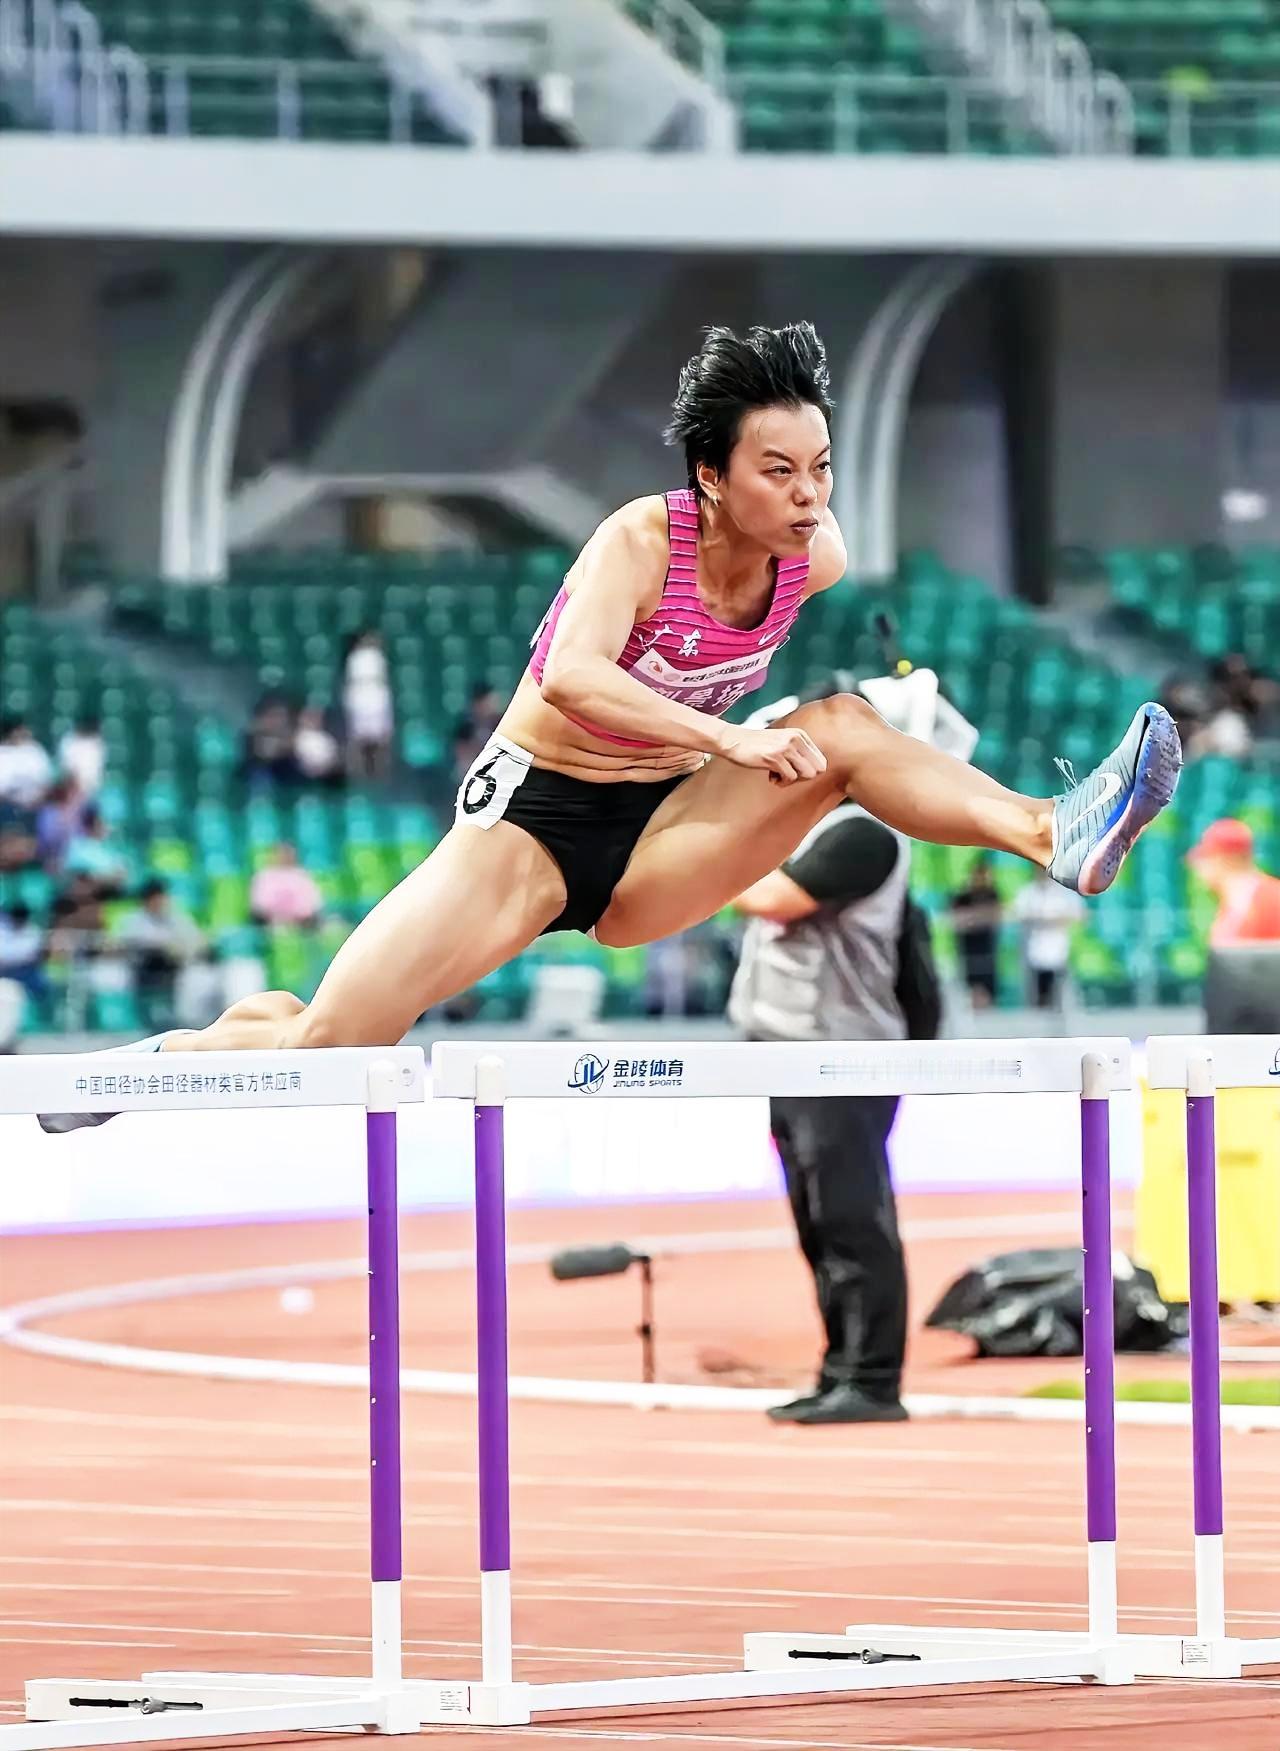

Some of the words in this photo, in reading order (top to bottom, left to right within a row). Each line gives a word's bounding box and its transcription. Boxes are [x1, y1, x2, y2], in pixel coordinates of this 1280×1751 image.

[638, 623, 702, 657] 广东
[463, 748, 508, 814] 6
[613, 1059, 684, 1077] 金陵体育
[75, 1071, 302, 1096] 中国田径协会田径器材类官方供应商
[649, 1079, 683, 1087] SPORTS
